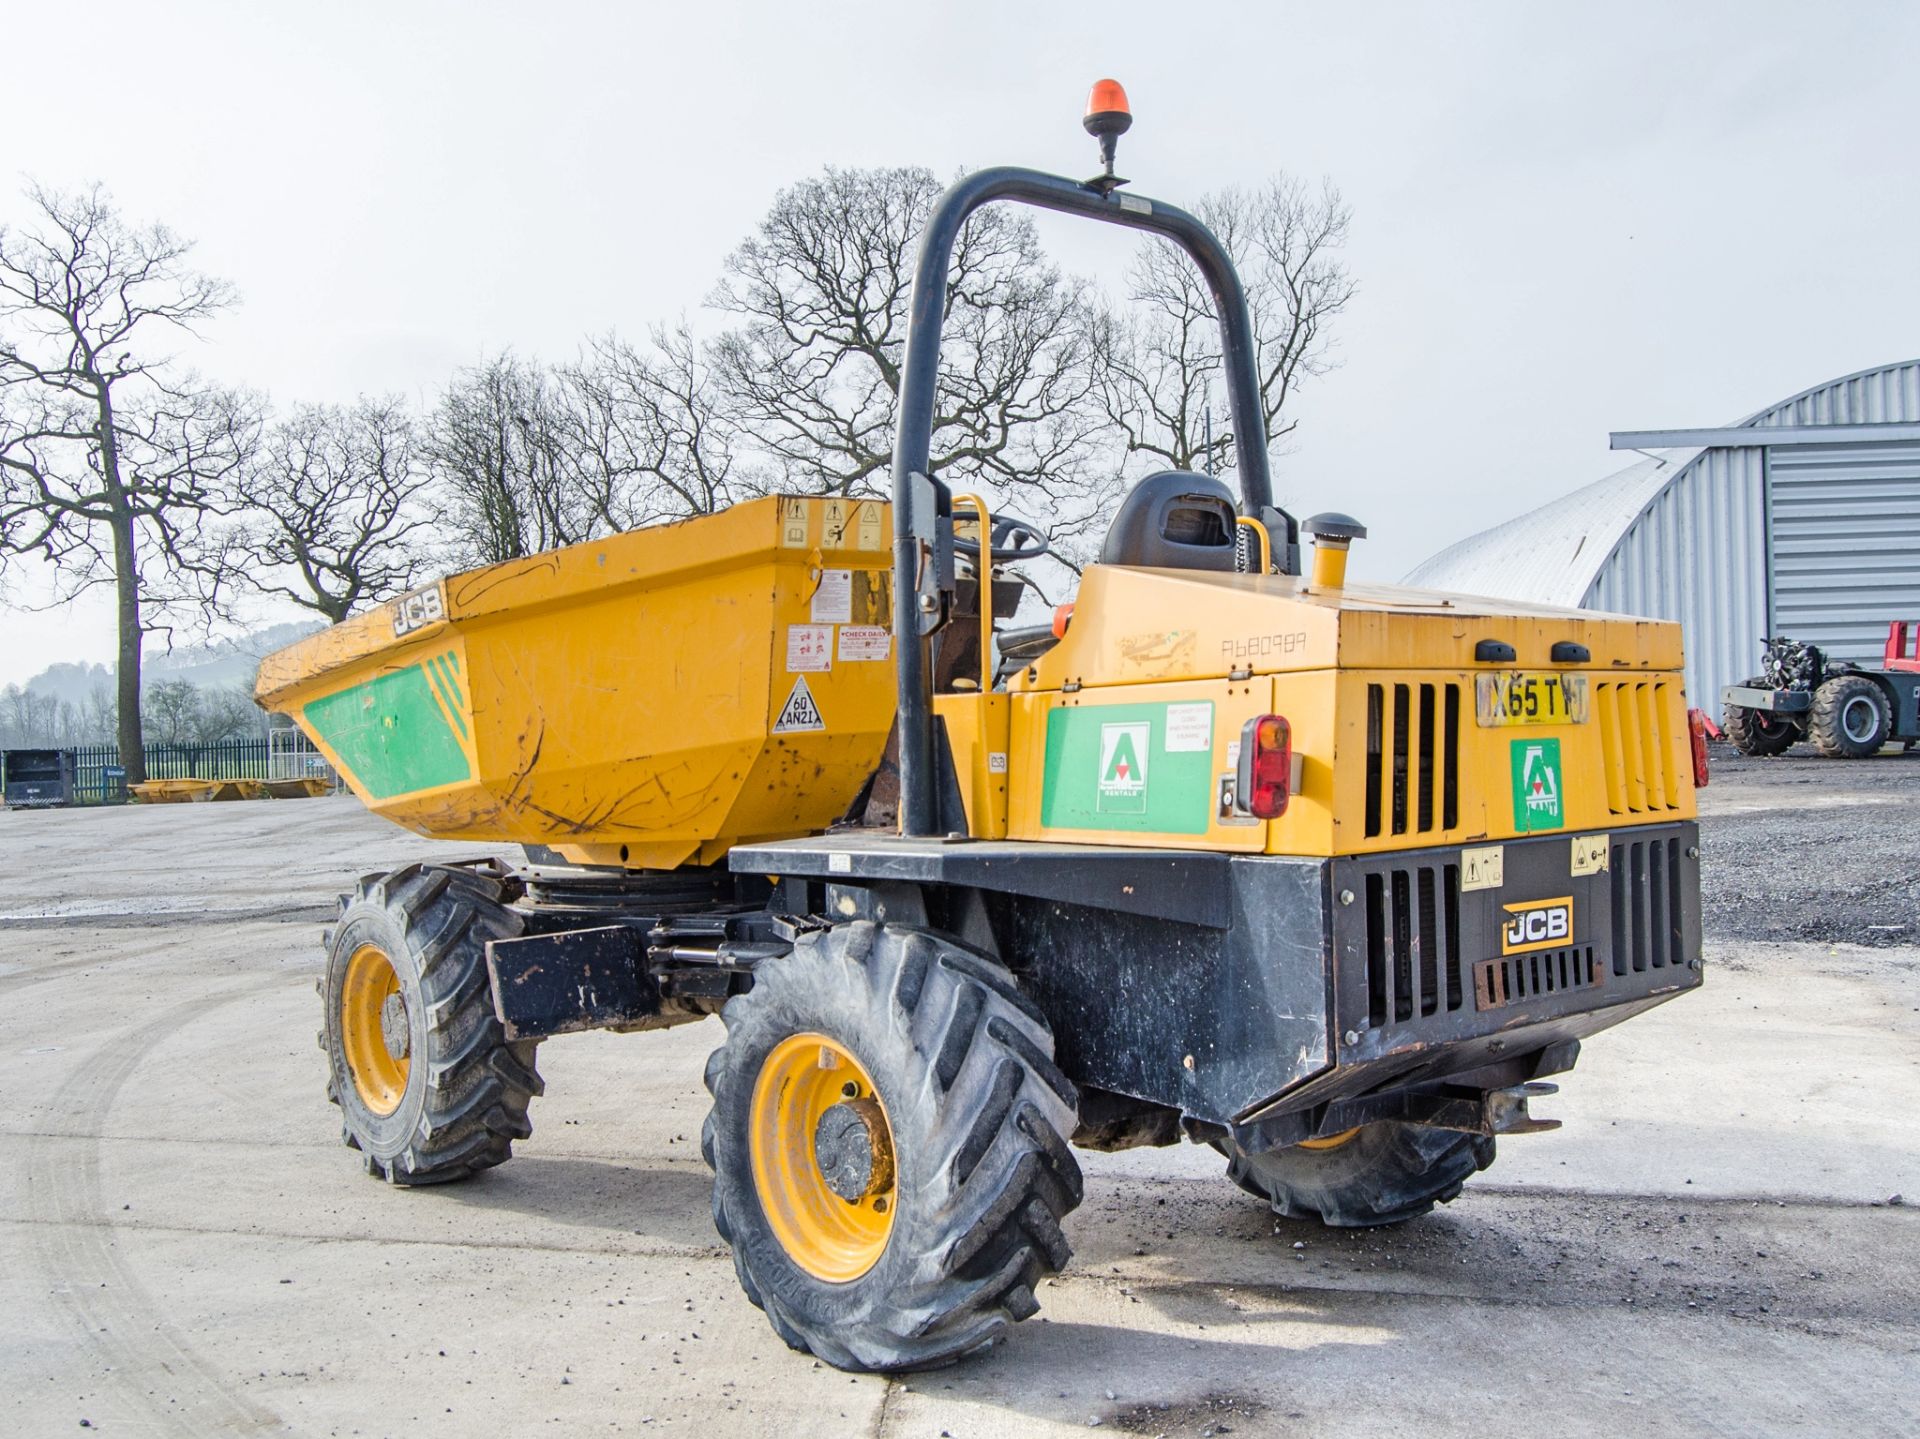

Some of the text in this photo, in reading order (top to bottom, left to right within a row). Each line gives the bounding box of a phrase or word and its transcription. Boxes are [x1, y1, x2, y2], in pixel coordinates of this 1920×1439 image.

[393, 587, 443, 635] JCB
[868, 630, 886, 638] DAILY
[786, 710, 813, 725] AN21
[1508, 907, 1568, 944] JCB
